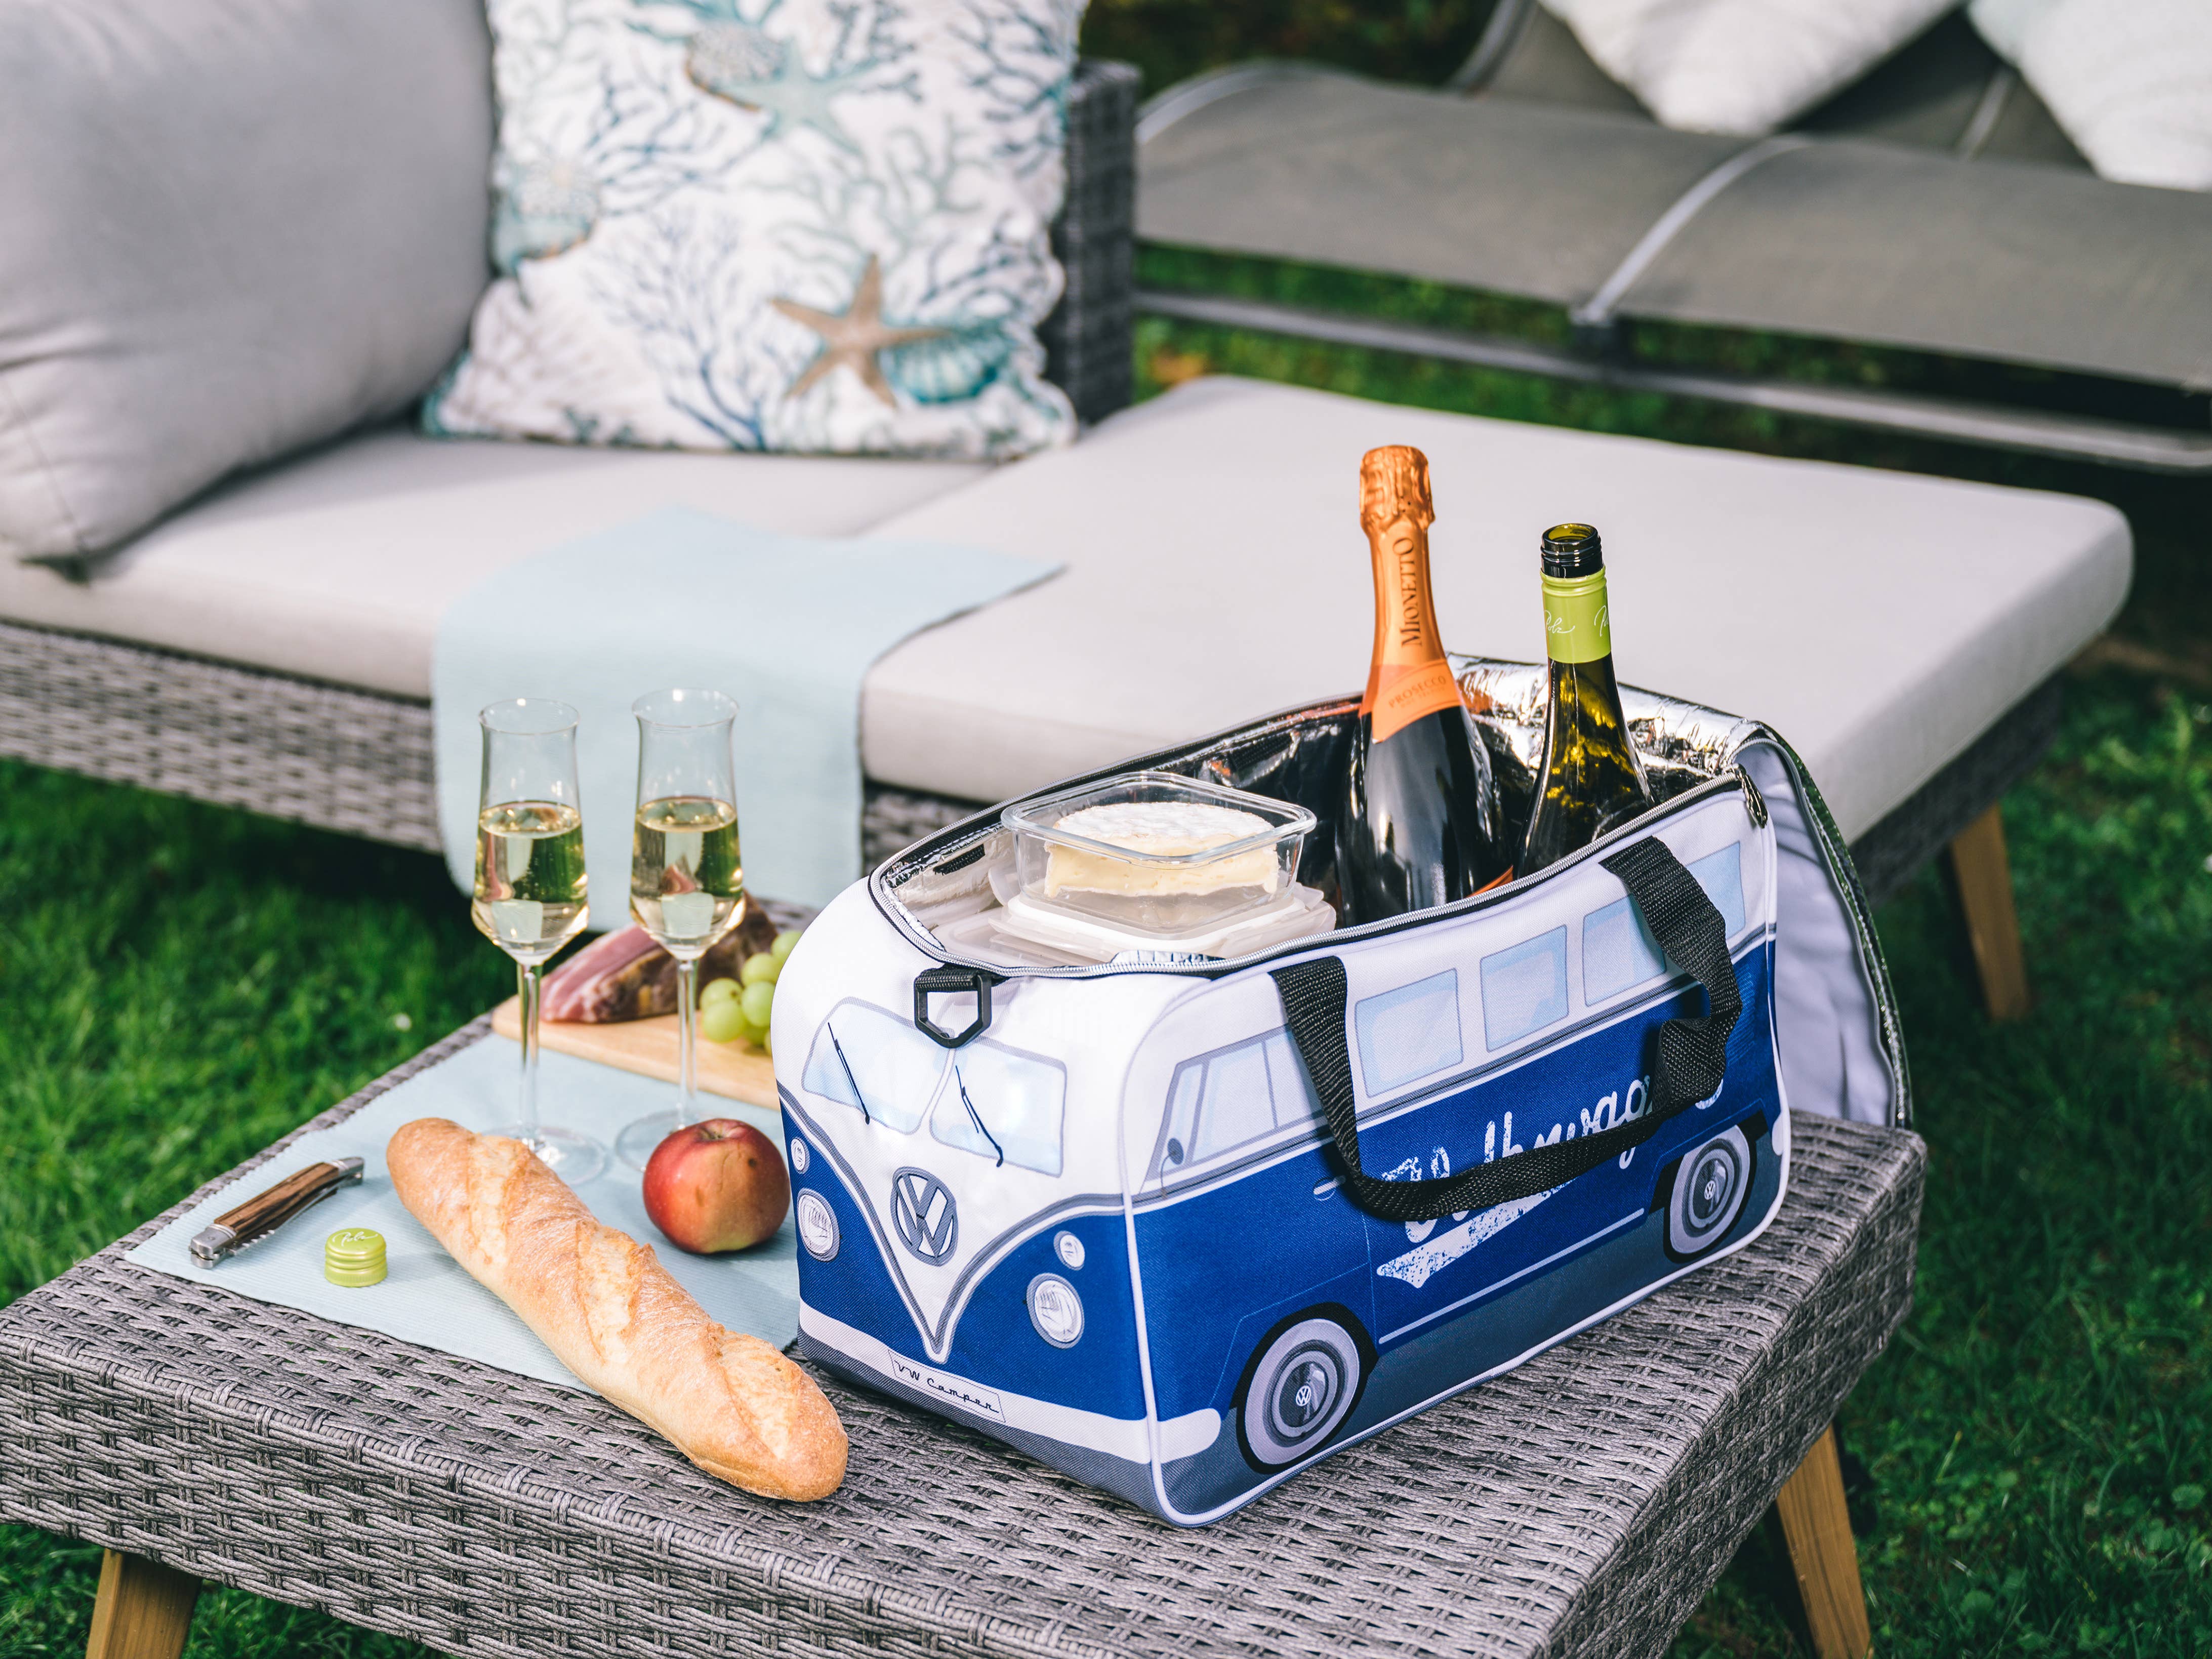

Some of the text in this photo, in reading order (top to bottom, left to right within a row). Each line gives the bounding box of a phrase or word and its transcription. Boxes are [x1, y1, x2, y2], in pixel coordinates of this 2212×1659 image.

[1392, 537, 1423, 648] MIONETTO
[1388, 675, 1446, 708] PROSECCO
[894, 1359, 1000, 1413] VW Camper
